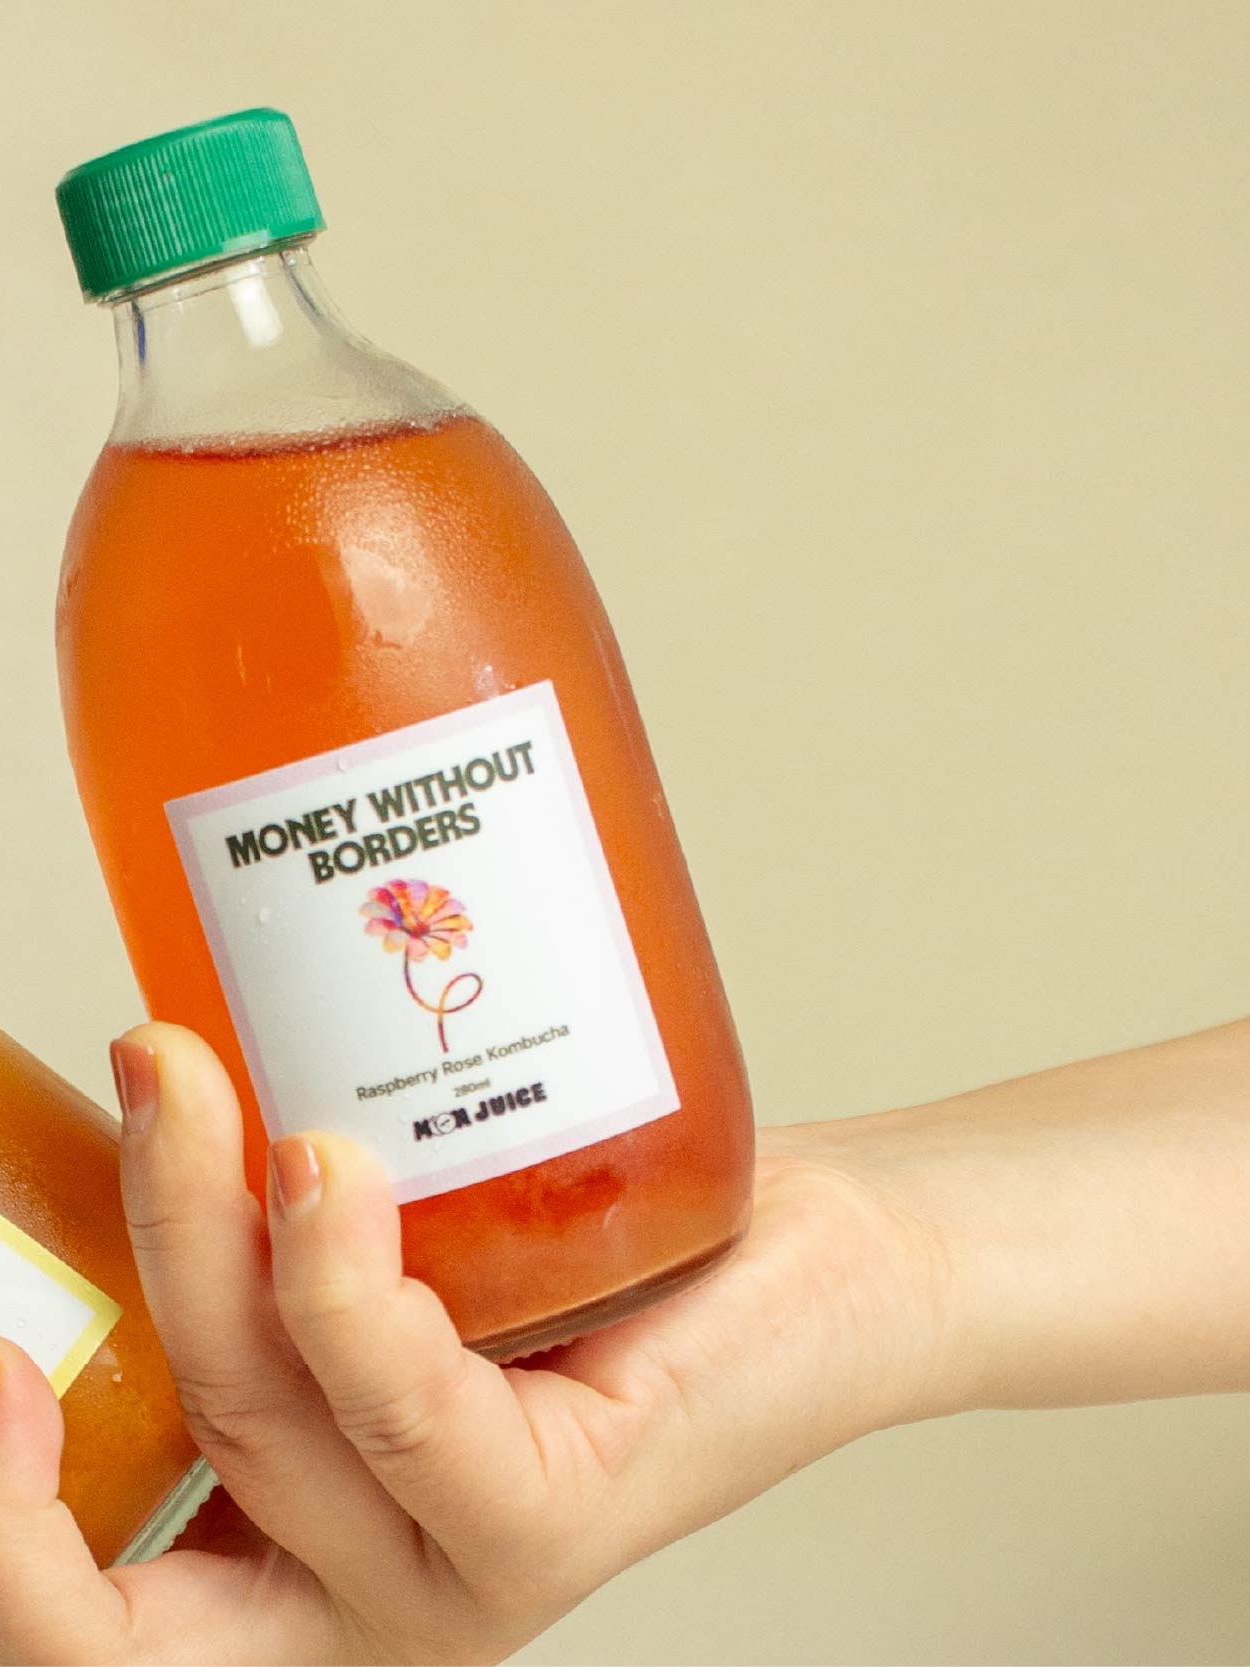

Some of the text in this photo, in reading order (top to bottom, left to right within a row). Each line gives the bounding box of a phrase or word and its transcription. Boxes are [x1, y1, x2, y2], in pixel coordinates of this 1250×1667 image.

[226, 741, 535, 869] MONEY WITHOUT
[308, 803, 481, 884] BORDERS
[356, 1024, 570, 1101] Raspberry Rose Kombucha
[454, 1078, 491, 1098] 280ml
[475, 1082, 548, 1122] JUICE
